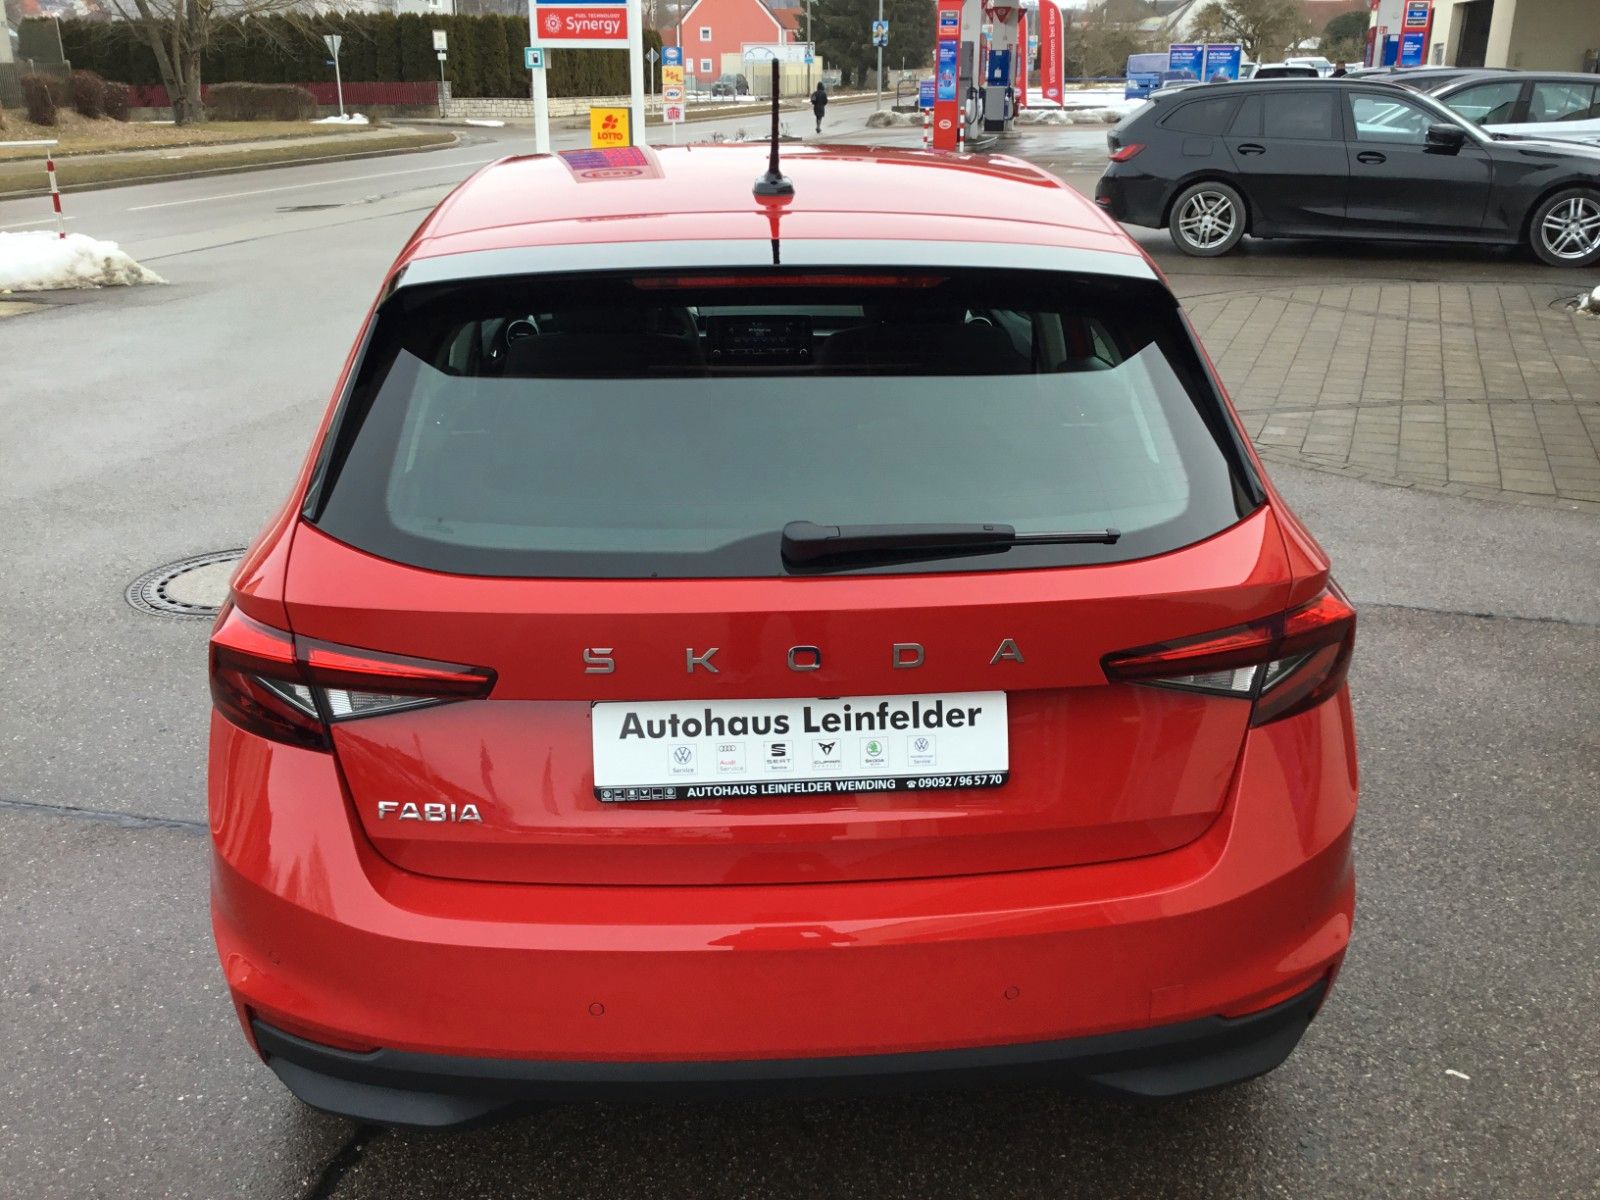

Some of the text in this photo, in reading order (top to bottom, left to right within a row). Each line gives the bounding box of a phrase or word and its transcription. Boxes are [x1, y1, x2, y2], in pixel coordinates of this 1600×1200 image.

[566, 16, 620, 34] Synergy
[597, 132, 623, 140] LOTTO
[582, 637, 1025, 674] SKODA
[619, 699, 982, 739] Autohaus Leinfelder
[687, 785, 757, 798] AUTOHAUS
[761, 781, 832, 795] LEINFELDER
[835, 779, 896, 791] WEMDING
[377, 800, 483, 823] FABIA
